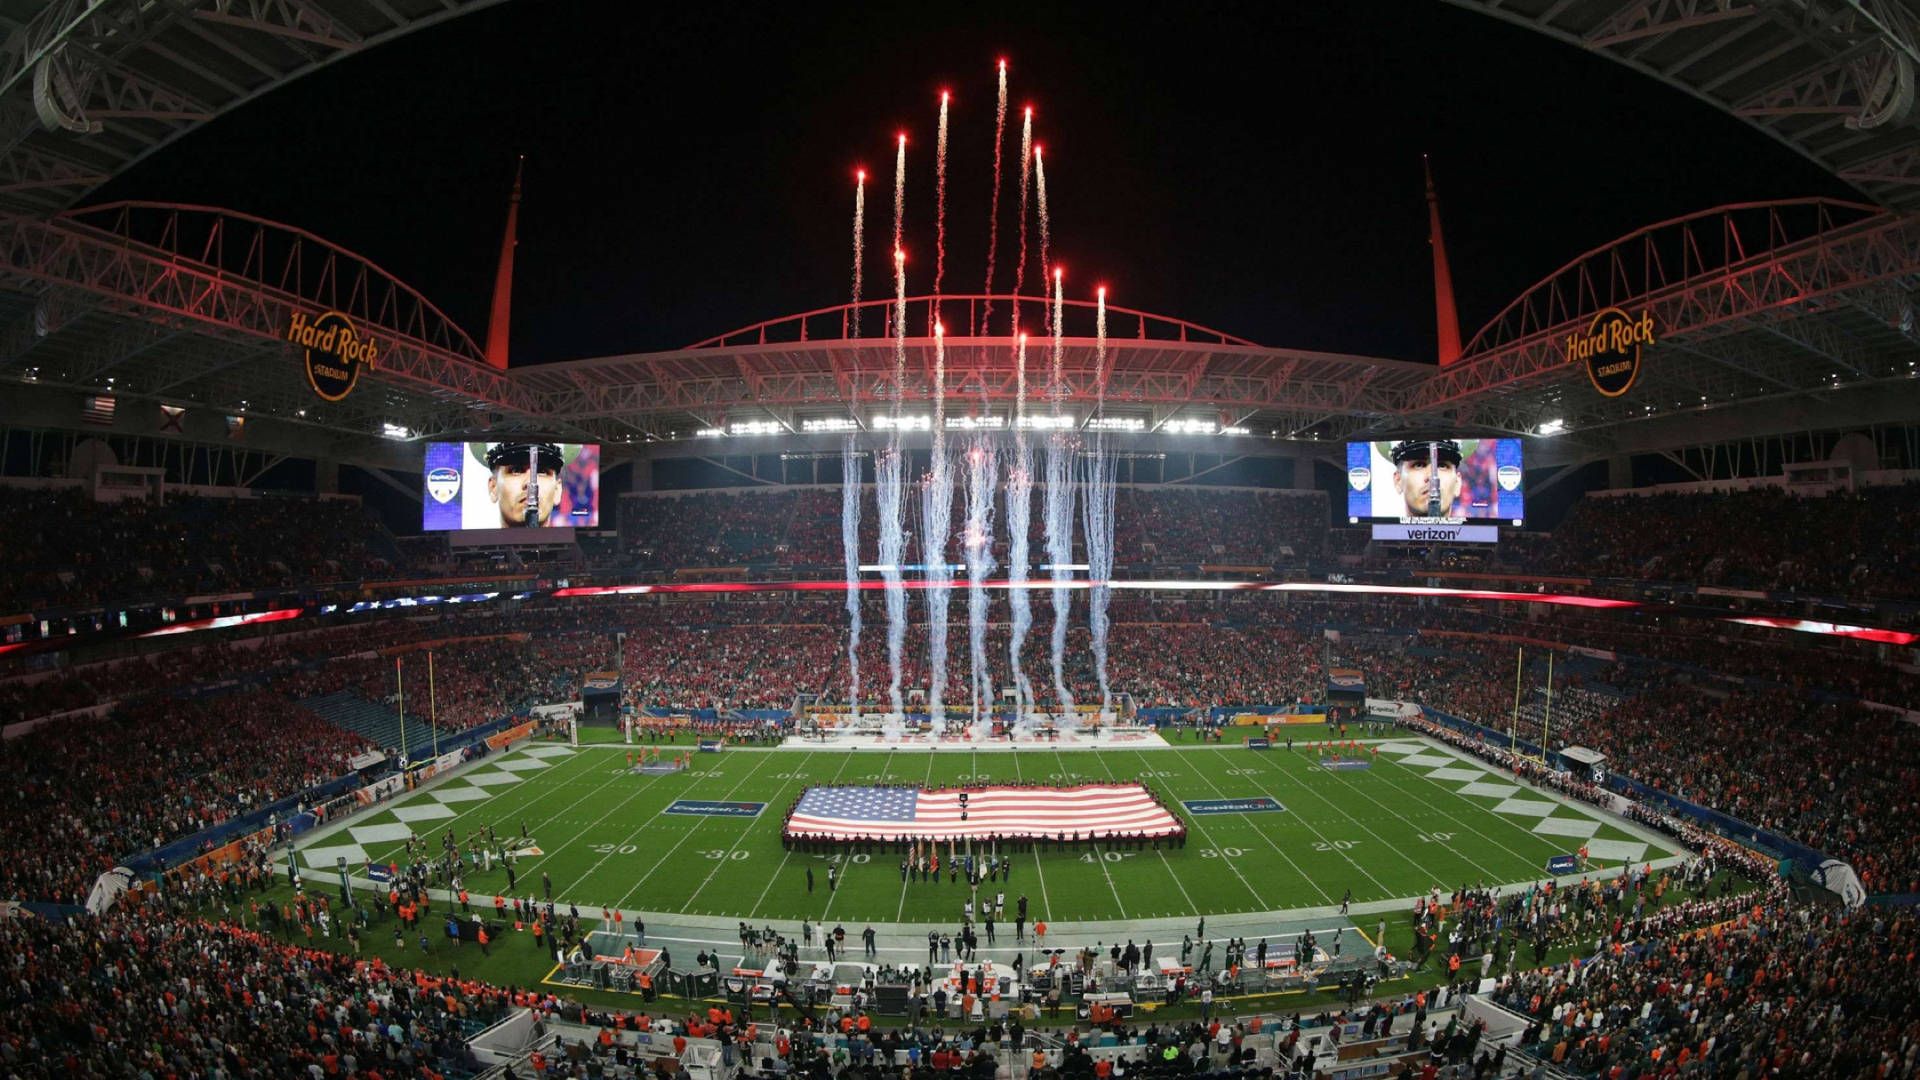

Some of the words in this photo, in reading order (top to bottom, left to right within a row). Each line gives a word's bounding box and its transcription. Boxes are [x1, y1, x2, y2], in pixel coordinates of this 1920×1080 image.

[287, 311, 338, 352] Hard
[337, 327, 378, 371] Rock
[1566, 322, 1608, 363] Hard
[1609, 309, 1655, 354] Rock
[313, 364, 349, 381] STADIUM
[1597, 360, 1632, 378] STADIUM
[1407, 527, 1456, 540] verizon
[1417, 832, 1452, 843] 10
[594, 843, 638, 854] 20
[1311, 840, 1353, 852] 20
[705, 849, 750, 861] 30
[825, 853, 871, 864] 40
[1080, 851, 1123, 864] 40
[1199, 847, 1243, 859] 30
